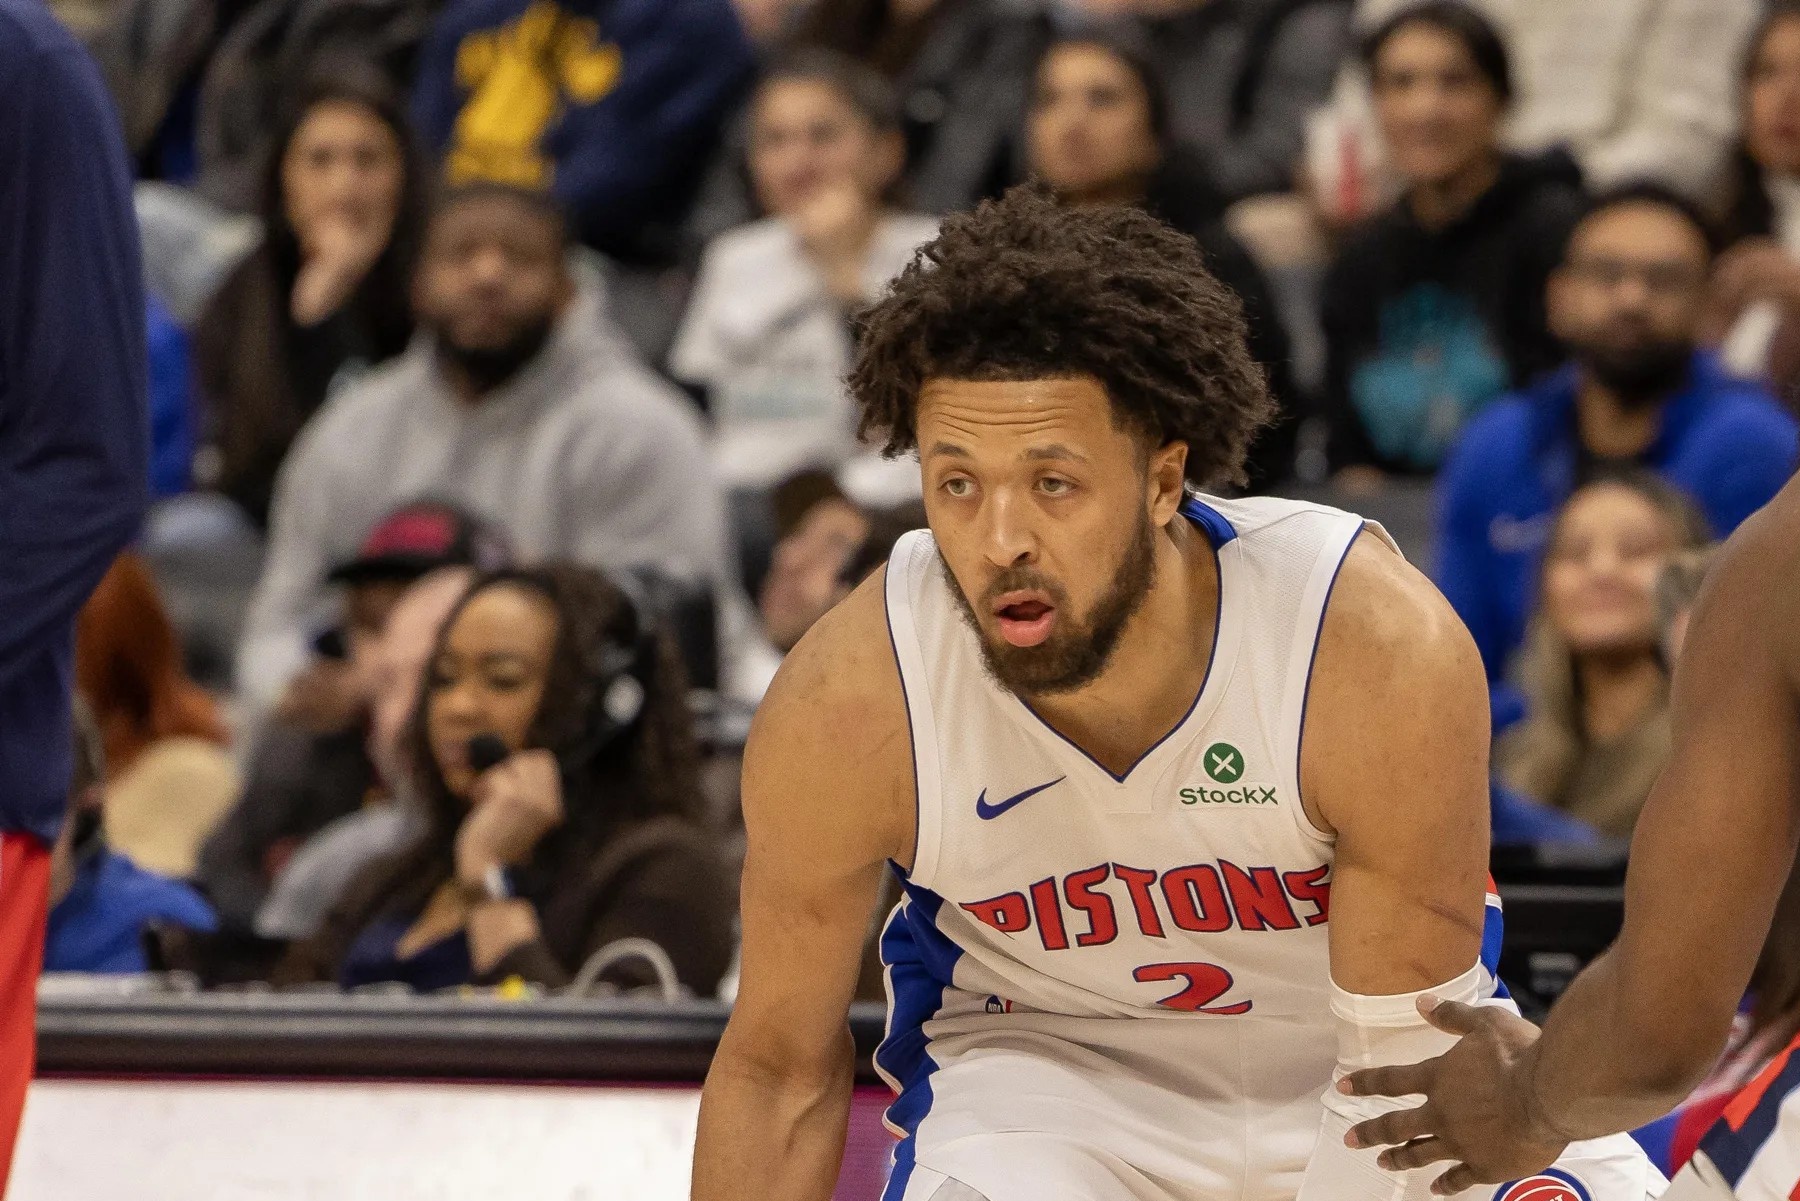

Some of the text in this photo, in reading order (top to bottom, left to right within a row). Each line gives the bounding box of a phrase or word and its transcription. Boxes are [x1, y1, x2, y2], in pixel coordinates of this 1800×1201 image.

[1179, 785, 1279, 805] StockX
[958, 858, 1331, 951] PISTONS
[1132, 962, 1253, 1015] 2
